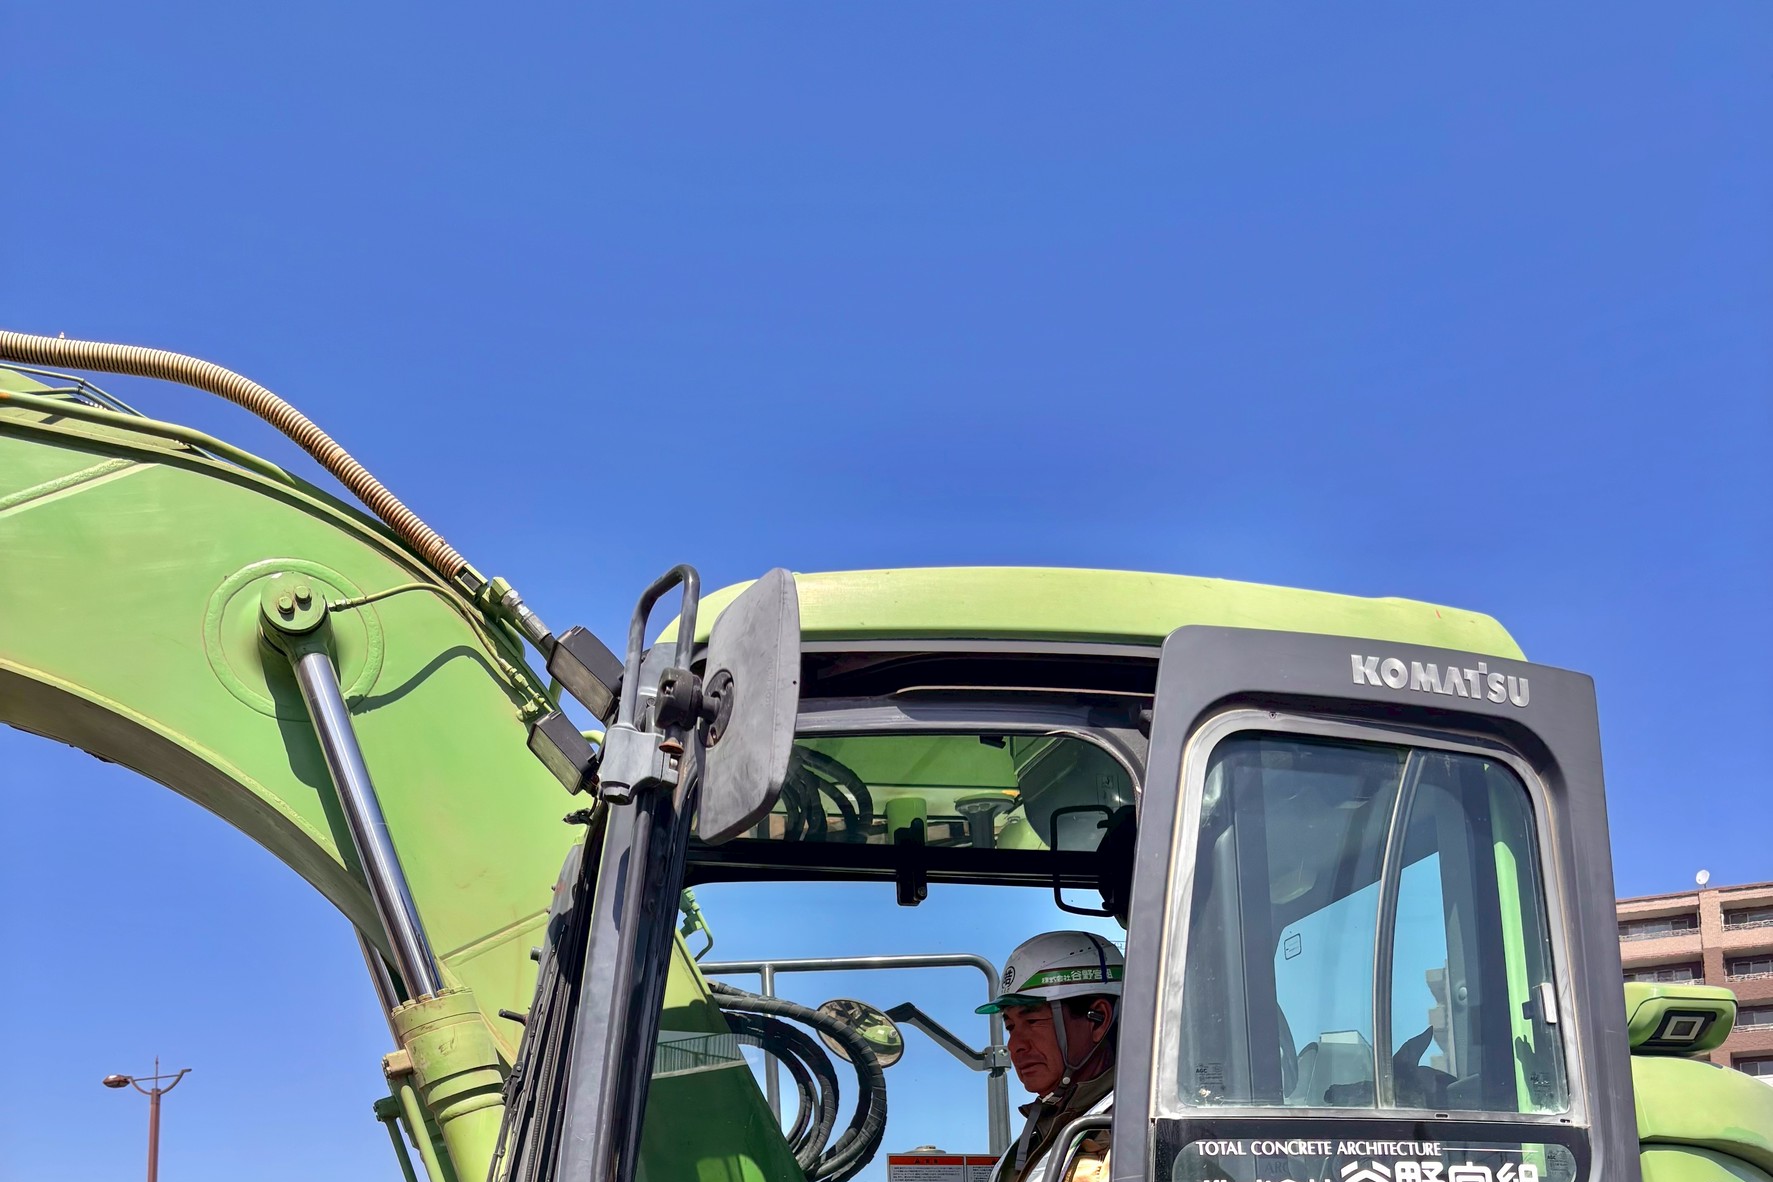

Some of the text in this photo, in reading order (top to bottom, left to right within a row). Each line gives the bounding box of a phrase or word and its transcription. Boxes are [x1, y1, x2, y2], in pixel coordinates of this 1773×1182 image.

[1351, 654, 1530, 708] KOMATSU
[1196, 1141, 1442, 1157] TOTAL CONCRETE ARCHITECTURE
